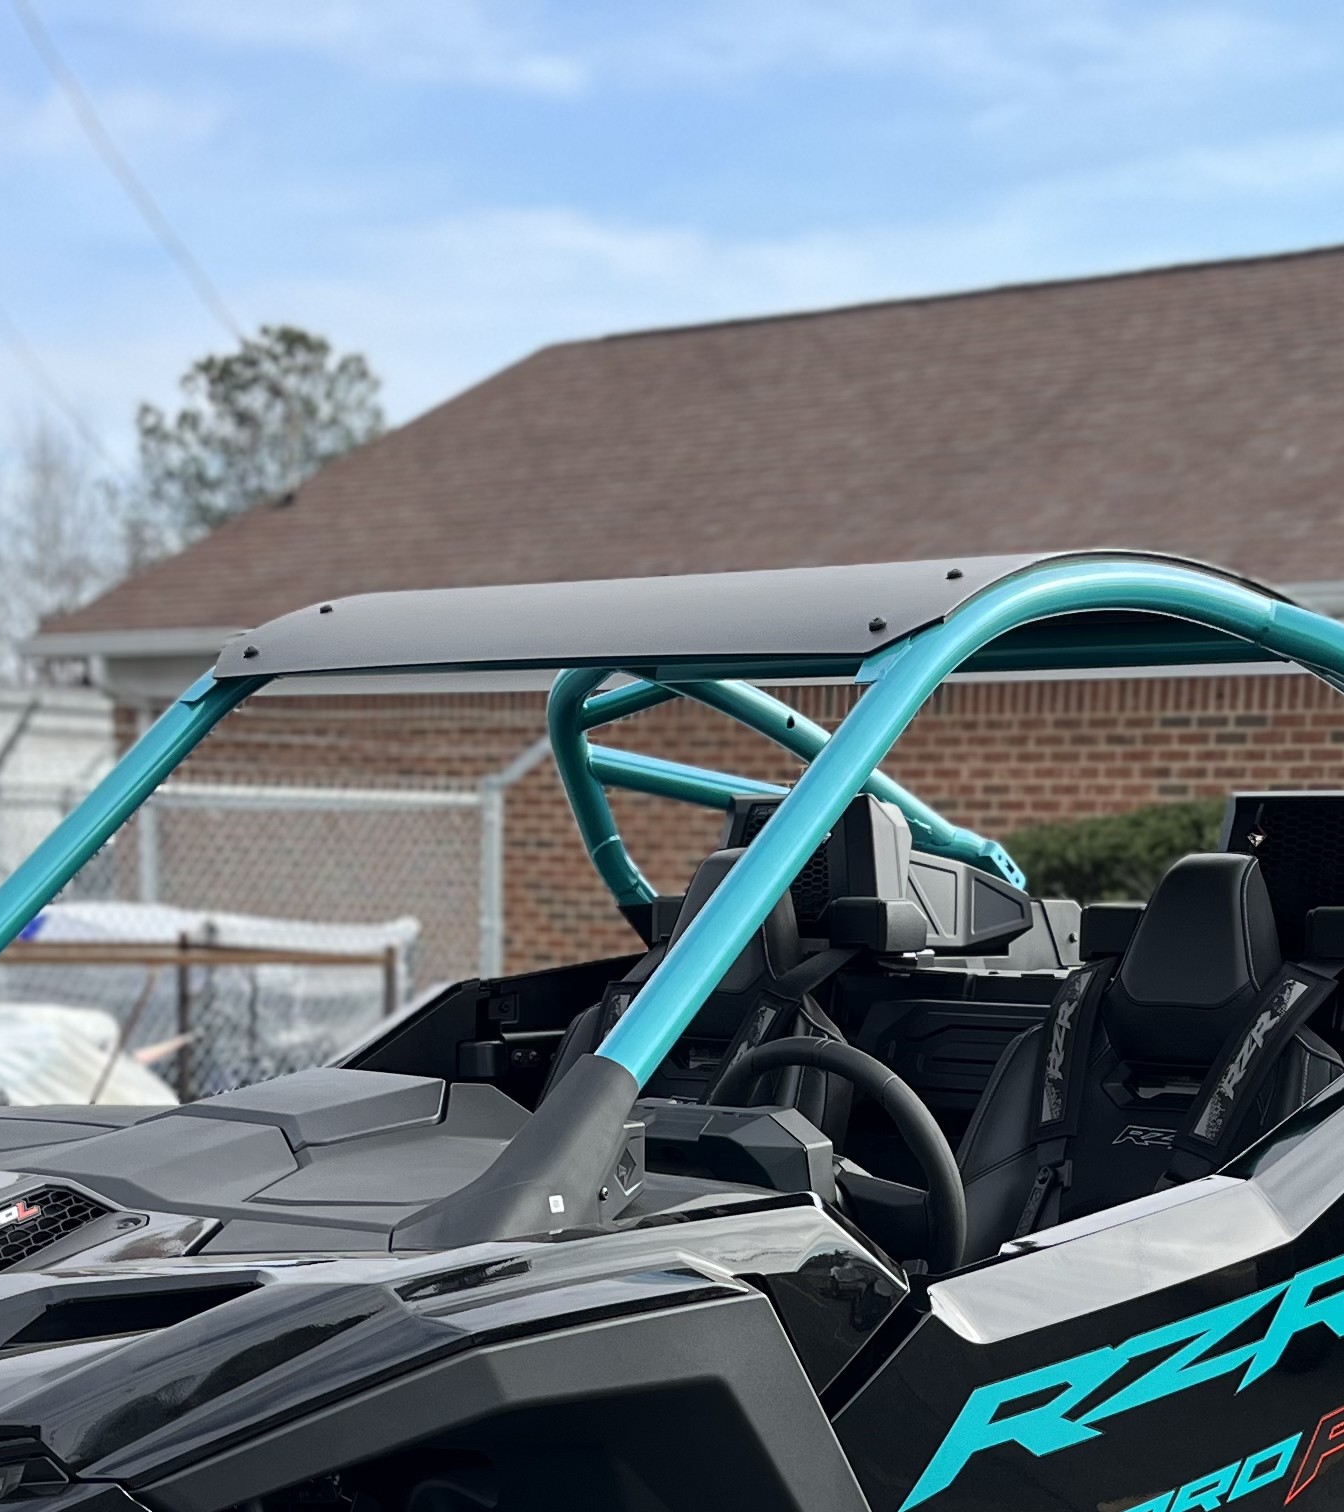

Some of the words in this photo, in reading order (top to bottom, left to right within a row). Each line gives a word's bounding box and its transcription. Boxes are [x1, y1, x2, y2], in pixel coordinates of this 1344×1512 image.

[1046, 1000, 1079, 1080] RZR
[1222, 1010, 1281, 1101] RZR
[1112, 1124, 1179, 1147] RZ
